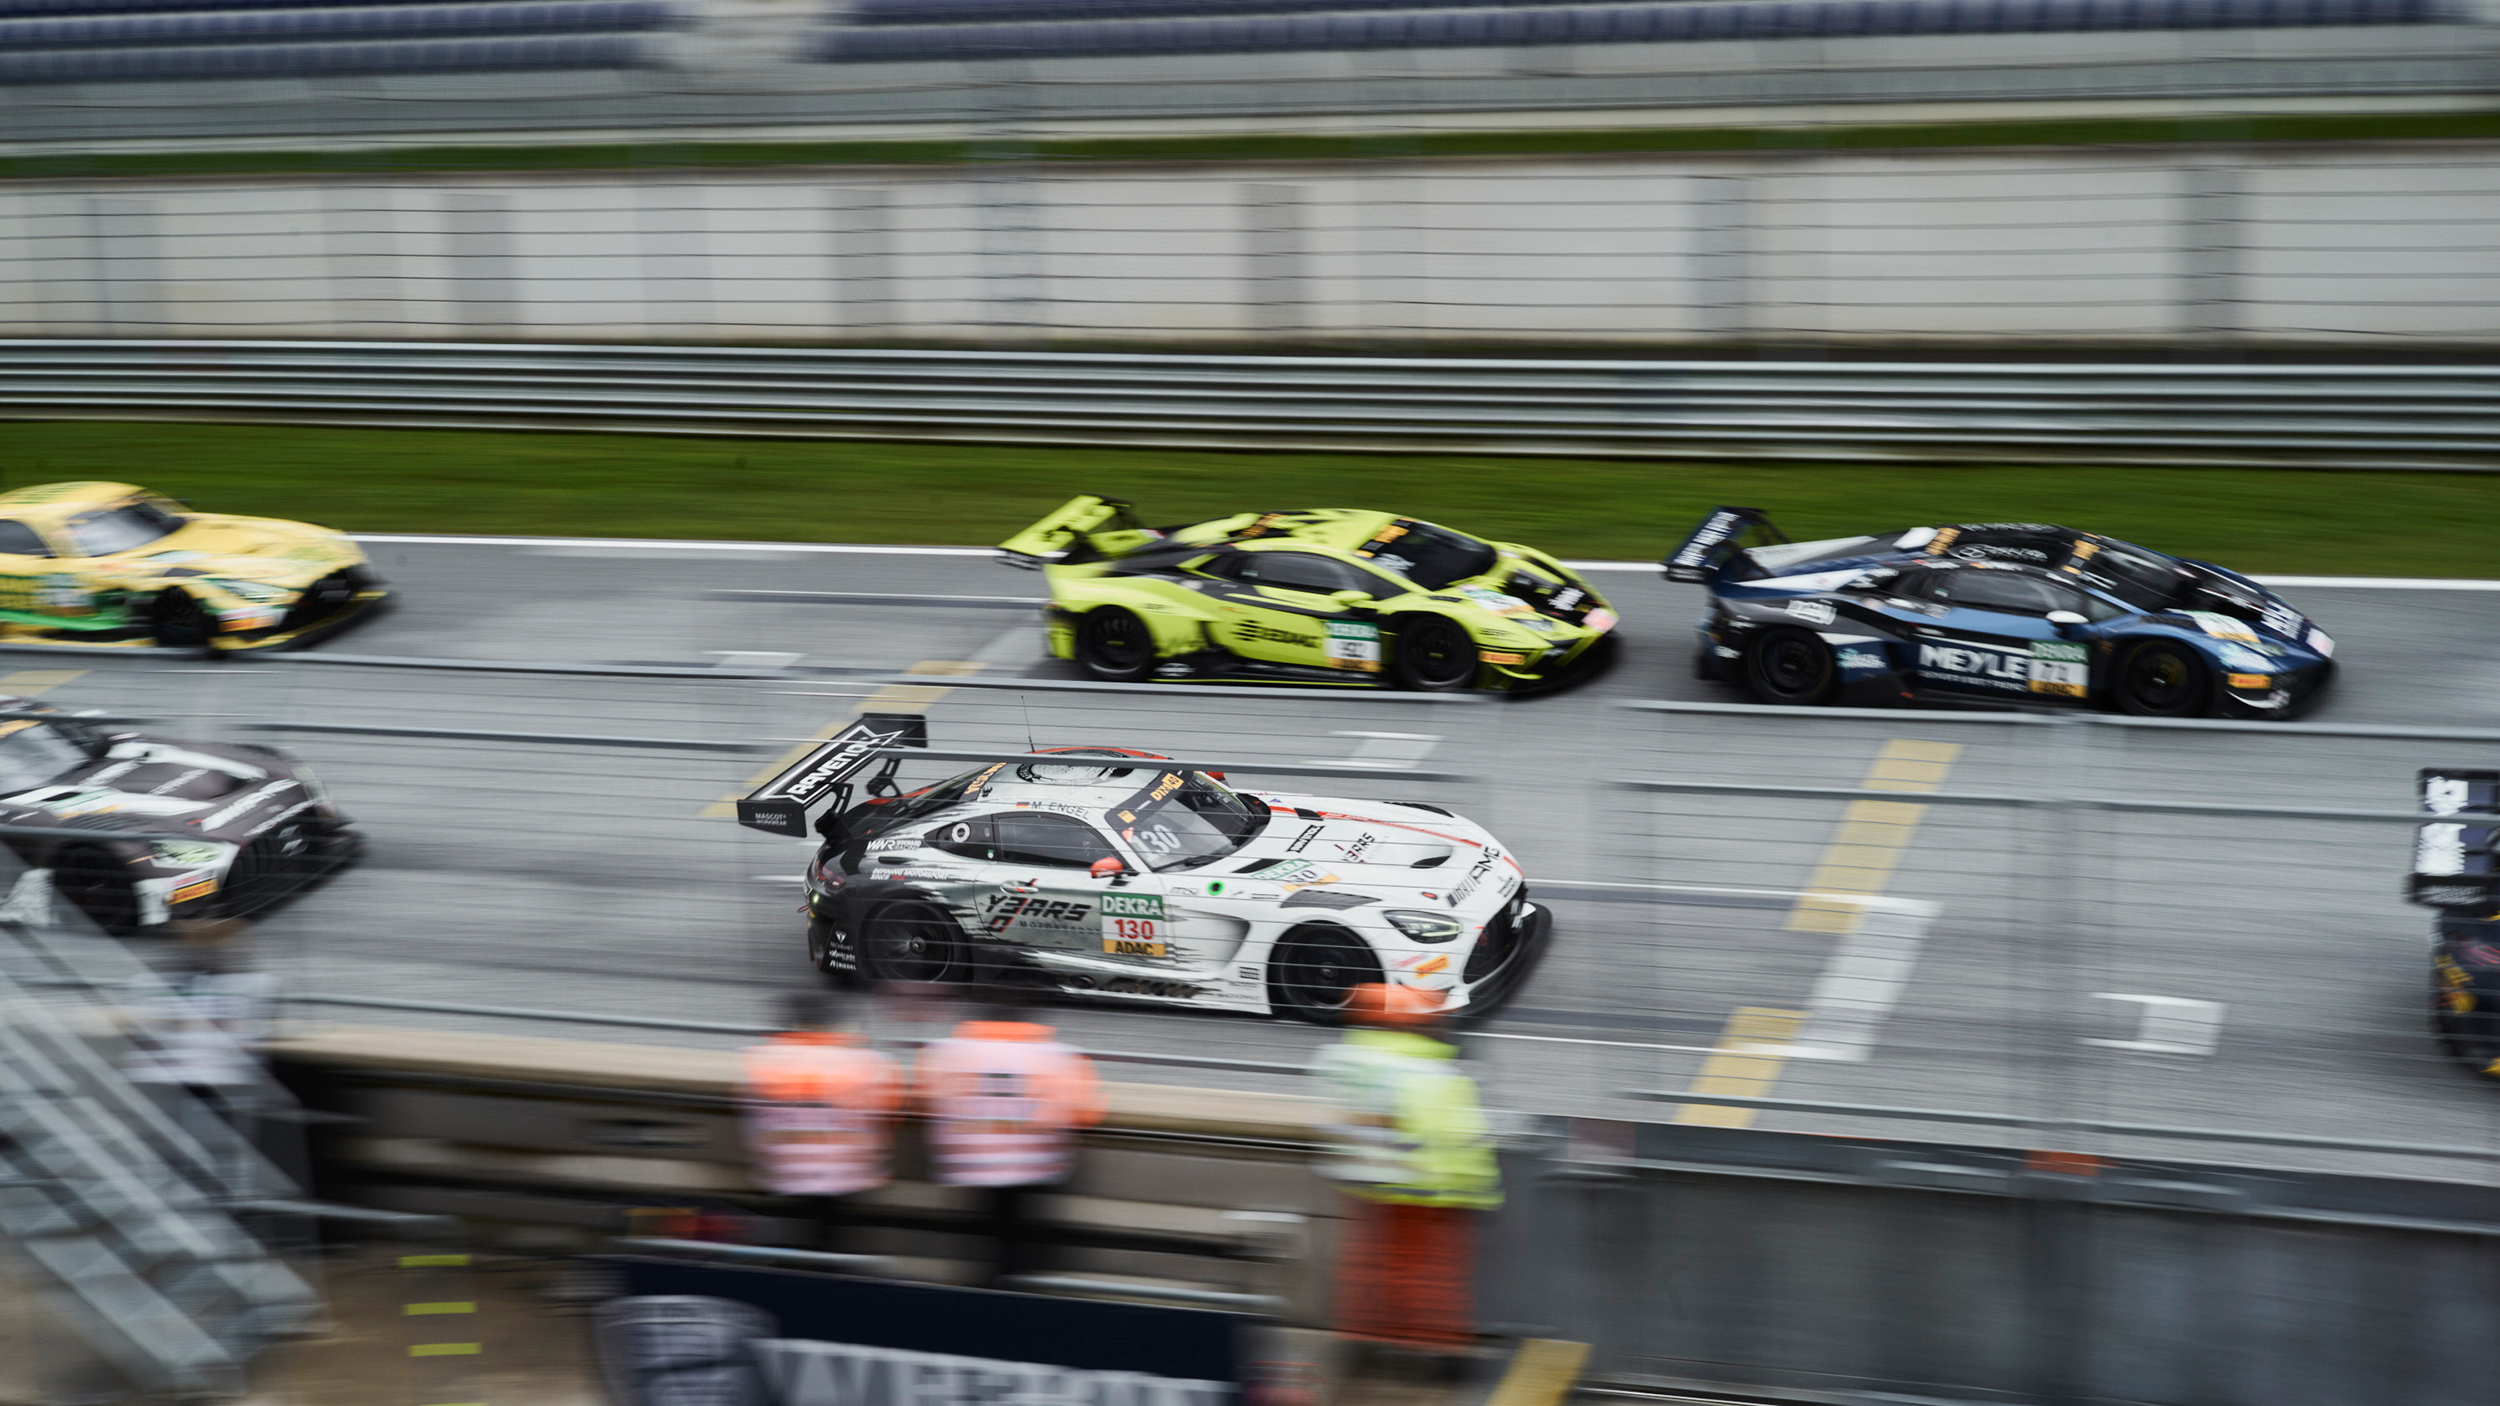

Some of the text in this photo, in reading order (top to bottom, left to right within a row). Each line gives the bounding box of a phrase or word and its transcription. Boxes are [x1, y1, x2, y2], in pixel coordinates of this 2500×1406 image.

[1920, 643, 2029, 681] MEYLE
[1049, 803, 1089, 820] ENGEL
[1102, 895, 1162, 916] DEKRA
[1114, 919, 1155, 940] 130
[1115, 941, 1153, 955] ADAC
